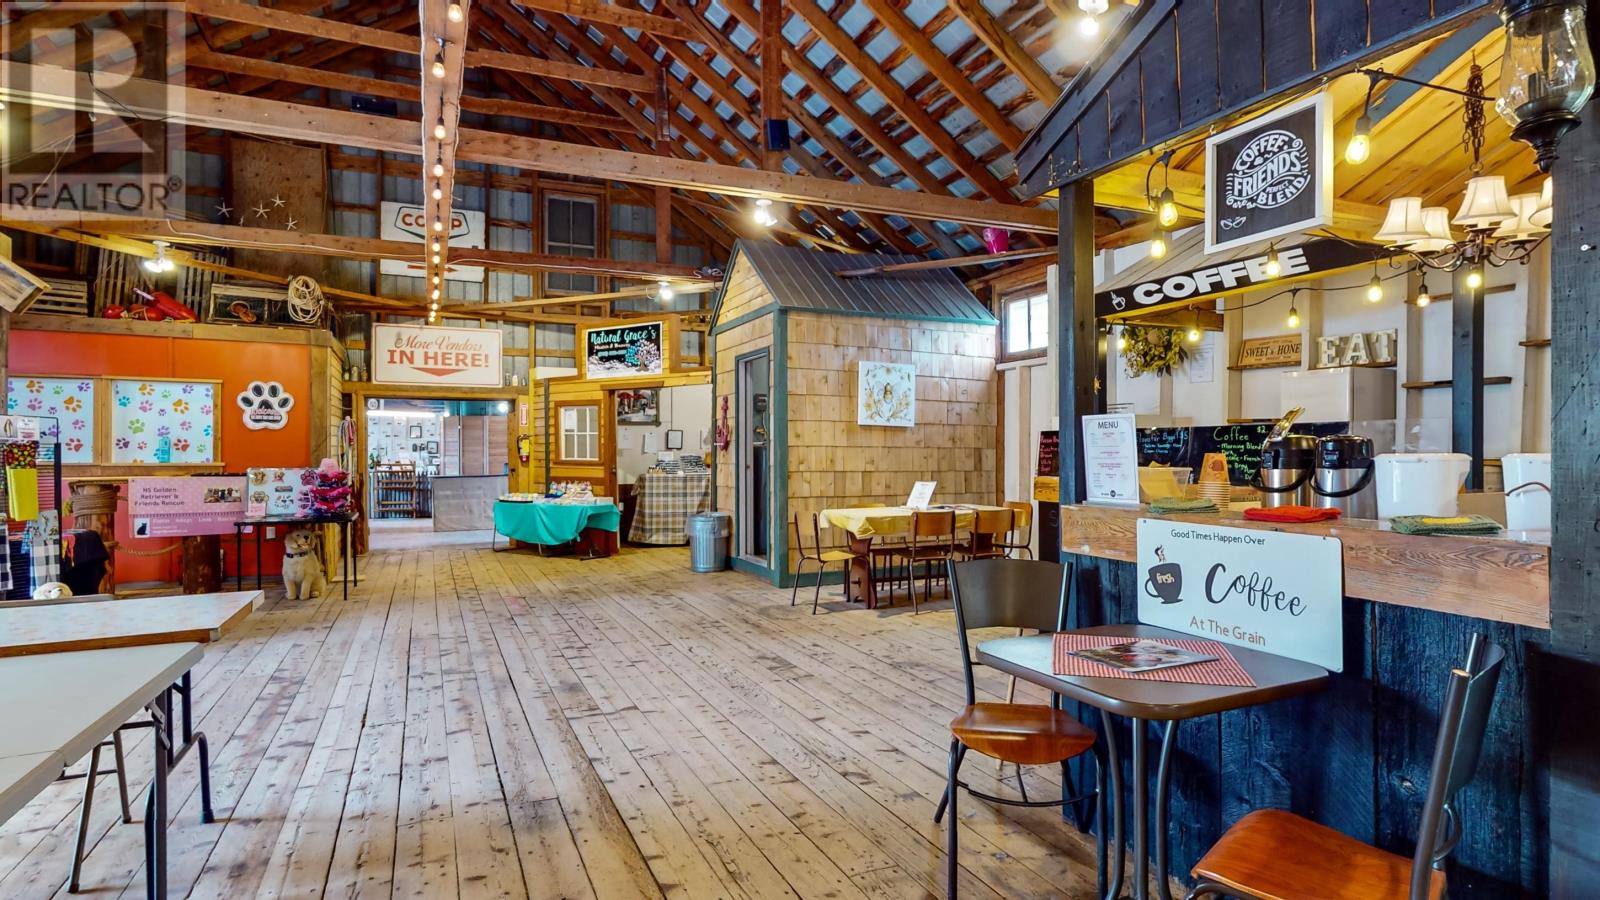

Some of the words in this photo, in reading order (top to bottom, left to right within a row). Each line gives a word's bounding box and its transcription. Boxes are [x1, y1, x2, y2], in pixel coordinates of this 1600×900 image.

[1235, 133, 1289, 170] COFFEE
[1233, 150, 1302, 198] FRIENDS
[1256, 177, 1306, 205] BLEND
[1132, 247, 1310, 305] COFFEE
[394, 333, 432, 351] More
[433, 336, 482, 351] Vendors
[590, 329, 621, 344] Natural
[623, 326, 656, 343] Grace's
[1245, 346, 1270, 358] SWEET
[1277, 343, 1301, 355] HONE
[1315, 329, 1397, 368] EAT
[387, 349, 415, 365] IN
[423, 351, 489, 368] HERE!
[1097, 421, 1119, 429] MENU
[1213, 426, 1249, 440] Coffee
[1221, 443, 1245, 452] Morning
[1170, 528, 1190, 539] Good
[1190, 530, 1212, 540] Times
[1213, 532, 1242, 544] Happen
[1243, 534, 1265, 545] Over
[1205, 563, 1307, 616] Coffee
[1189, 615, 1205, 631] At
[1207, 619, 1230, 637] The
[1232, 626, 1266, 647] Grain
